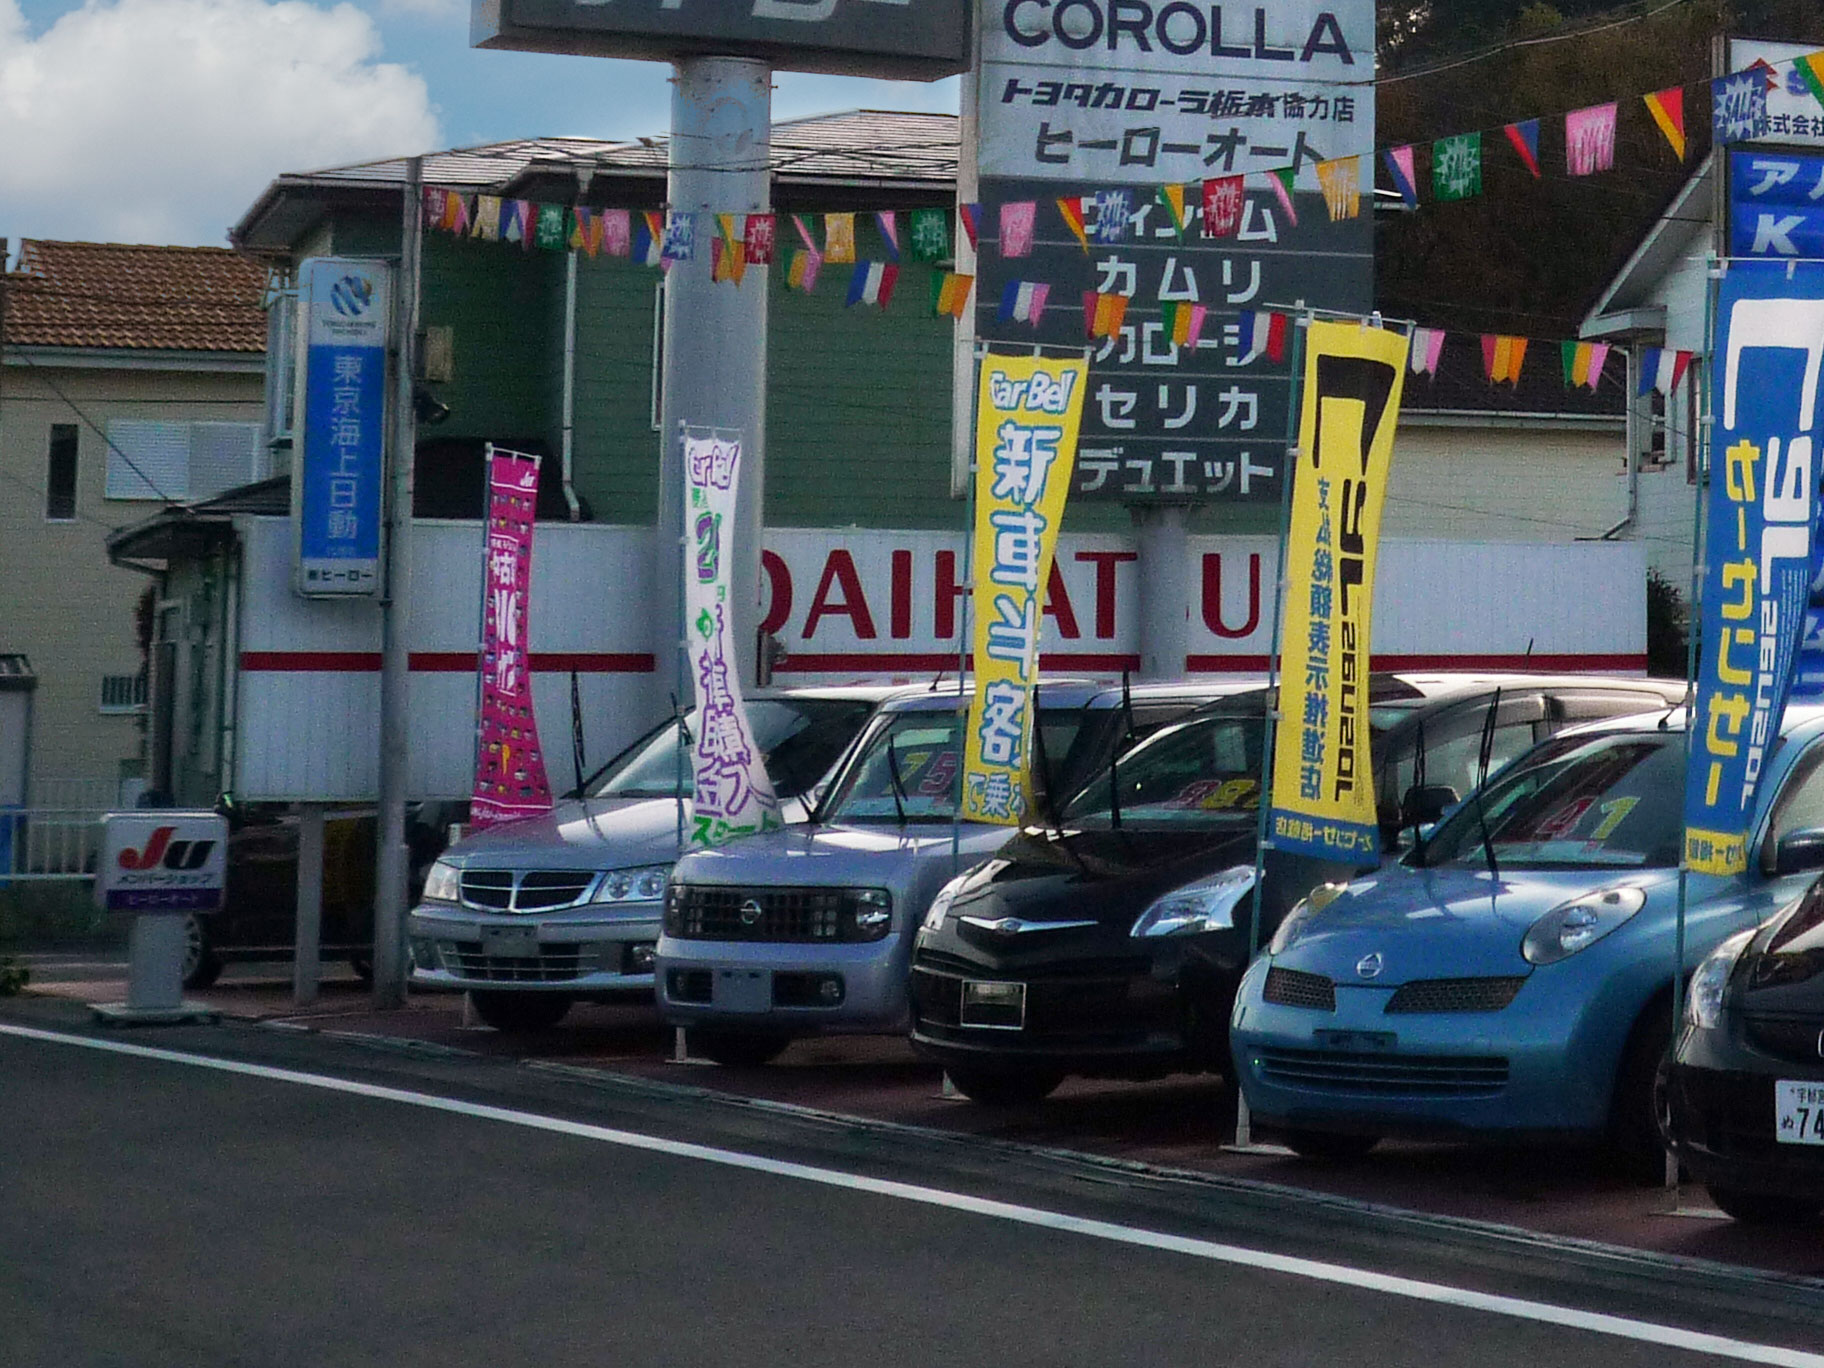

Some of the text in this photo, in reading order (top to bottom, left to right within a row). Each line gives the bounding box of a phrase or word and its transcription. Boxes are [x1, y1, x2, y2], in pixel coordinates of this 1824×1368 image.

[1035, 121, 1327, 175] ヒーローオート
[1096, 255, 1261, 303] カムリ
[1095, 383, 1259, 430] セリカ
[328, 354, 364, 541] 東京海上日動
[1078, 446, 1274, 495] デュエット
